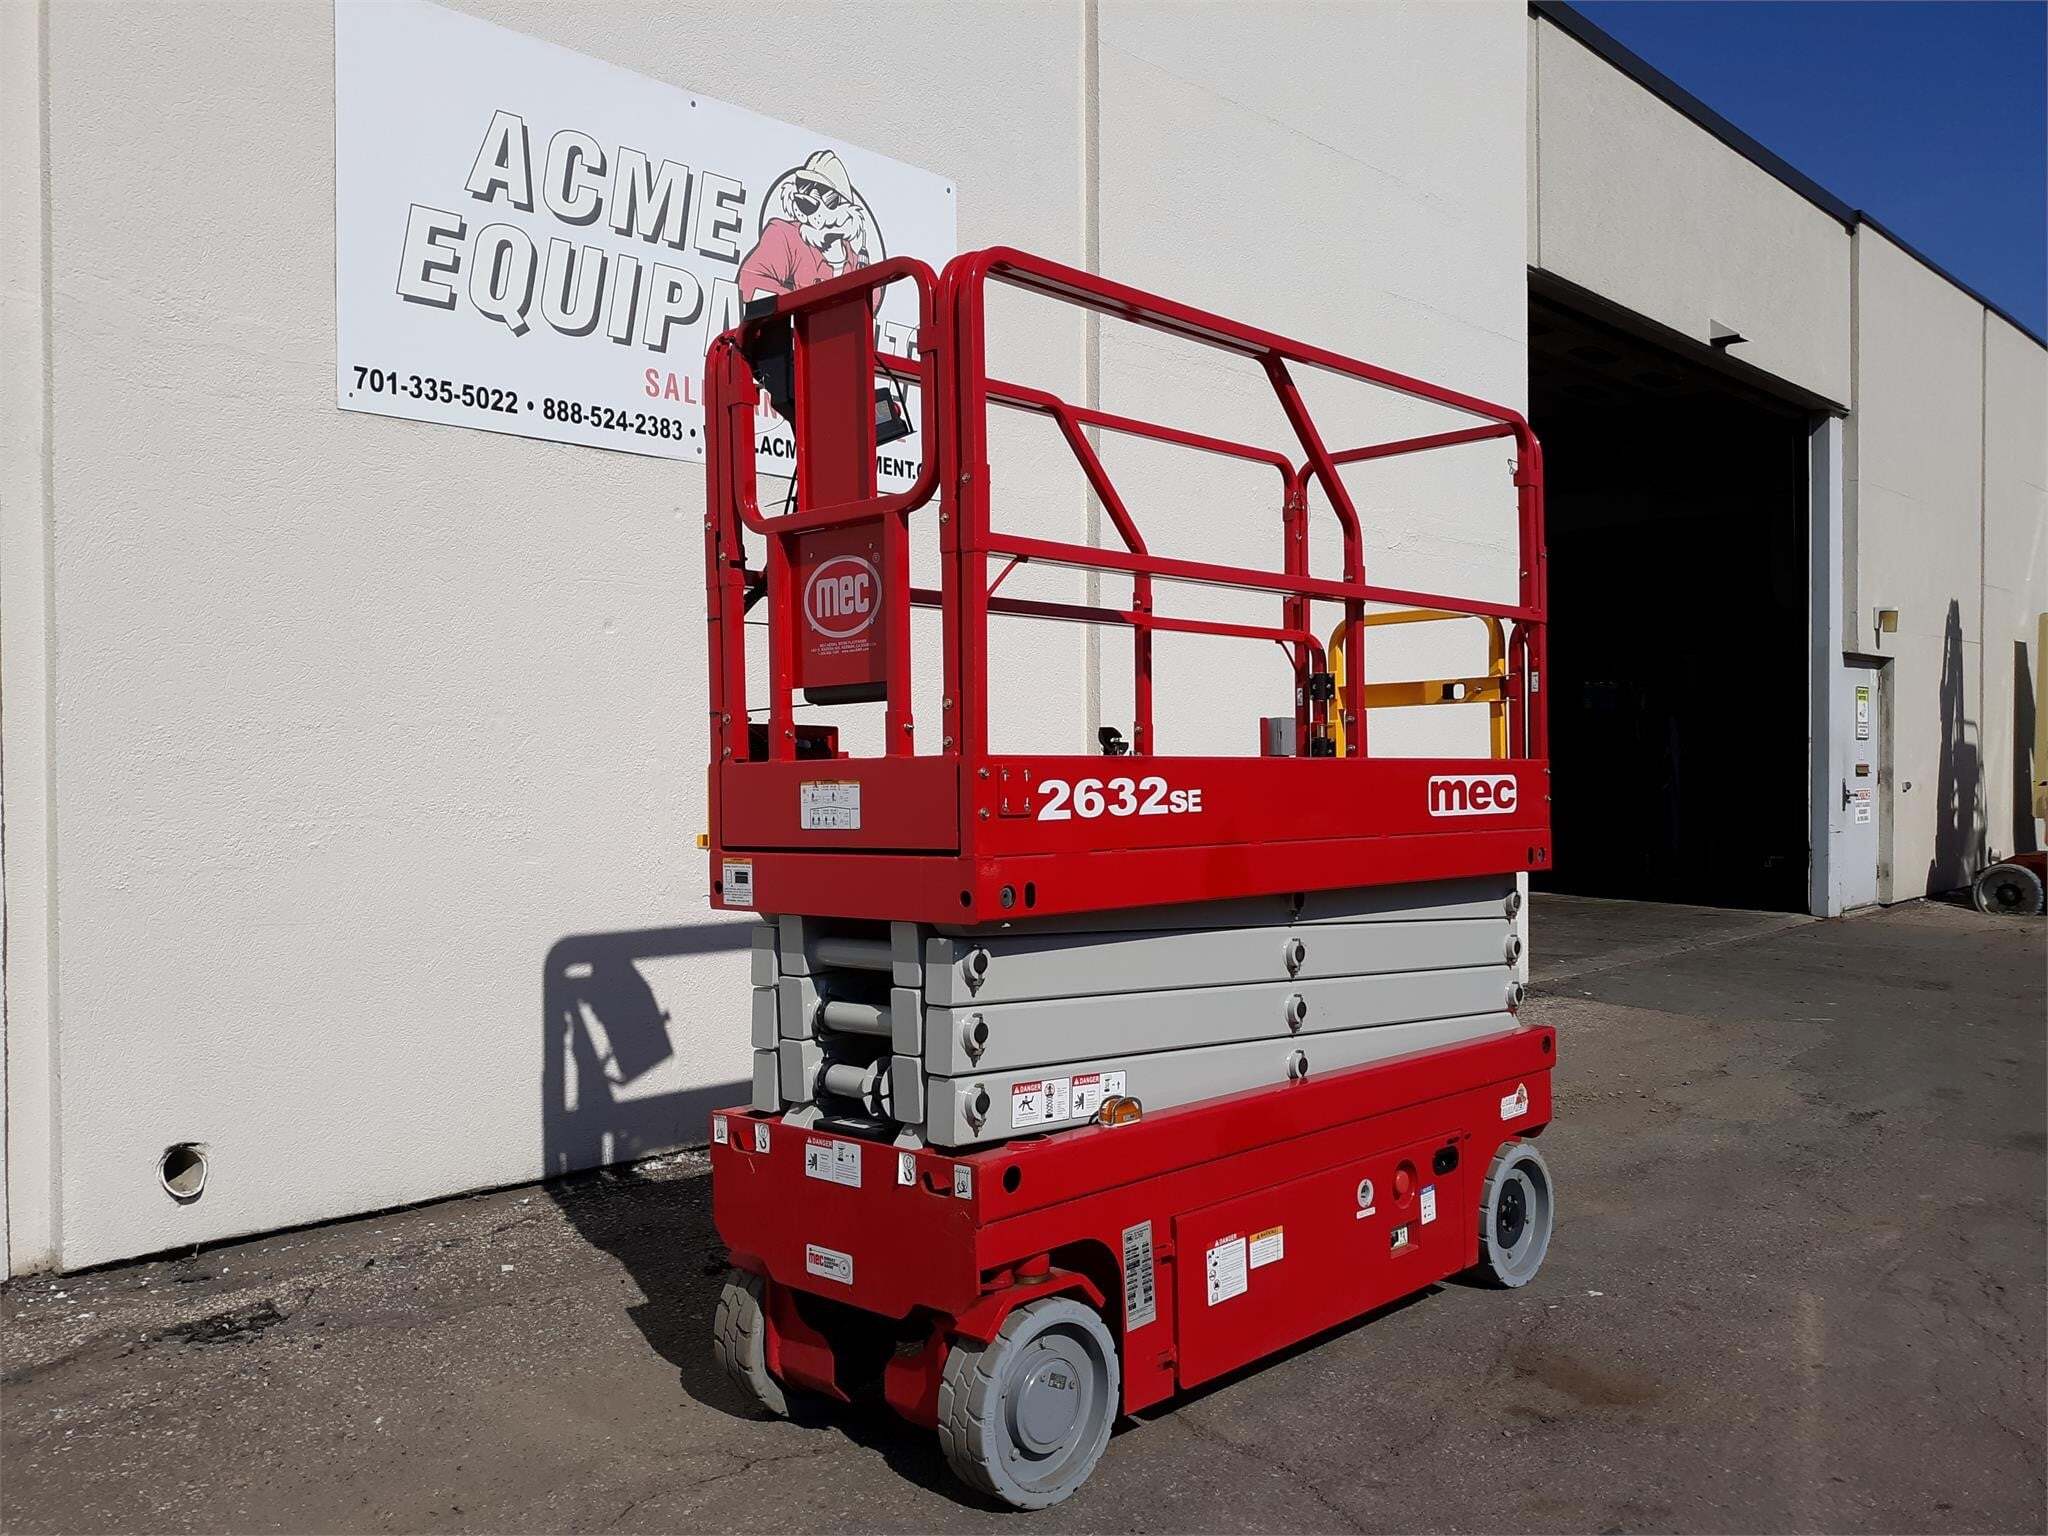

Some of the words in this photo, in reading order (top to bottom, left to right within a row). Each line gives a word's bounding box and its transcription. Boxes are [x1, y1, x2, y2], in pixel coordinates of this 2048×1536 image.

[464, 109, 746, 264] ACME
[353, 365, 518, 414] 701-335-5022
[543, 397, 683, 441] 888-524-2383
[816, 573, 869, 618] mec
[1431, 779, 1516, 812] mec
[1020, 1083, 1042, 1093] DANGER
[1079, 1076, 1099, 1084] DANGER
[812, 1137, 833, 1147] DANGER
